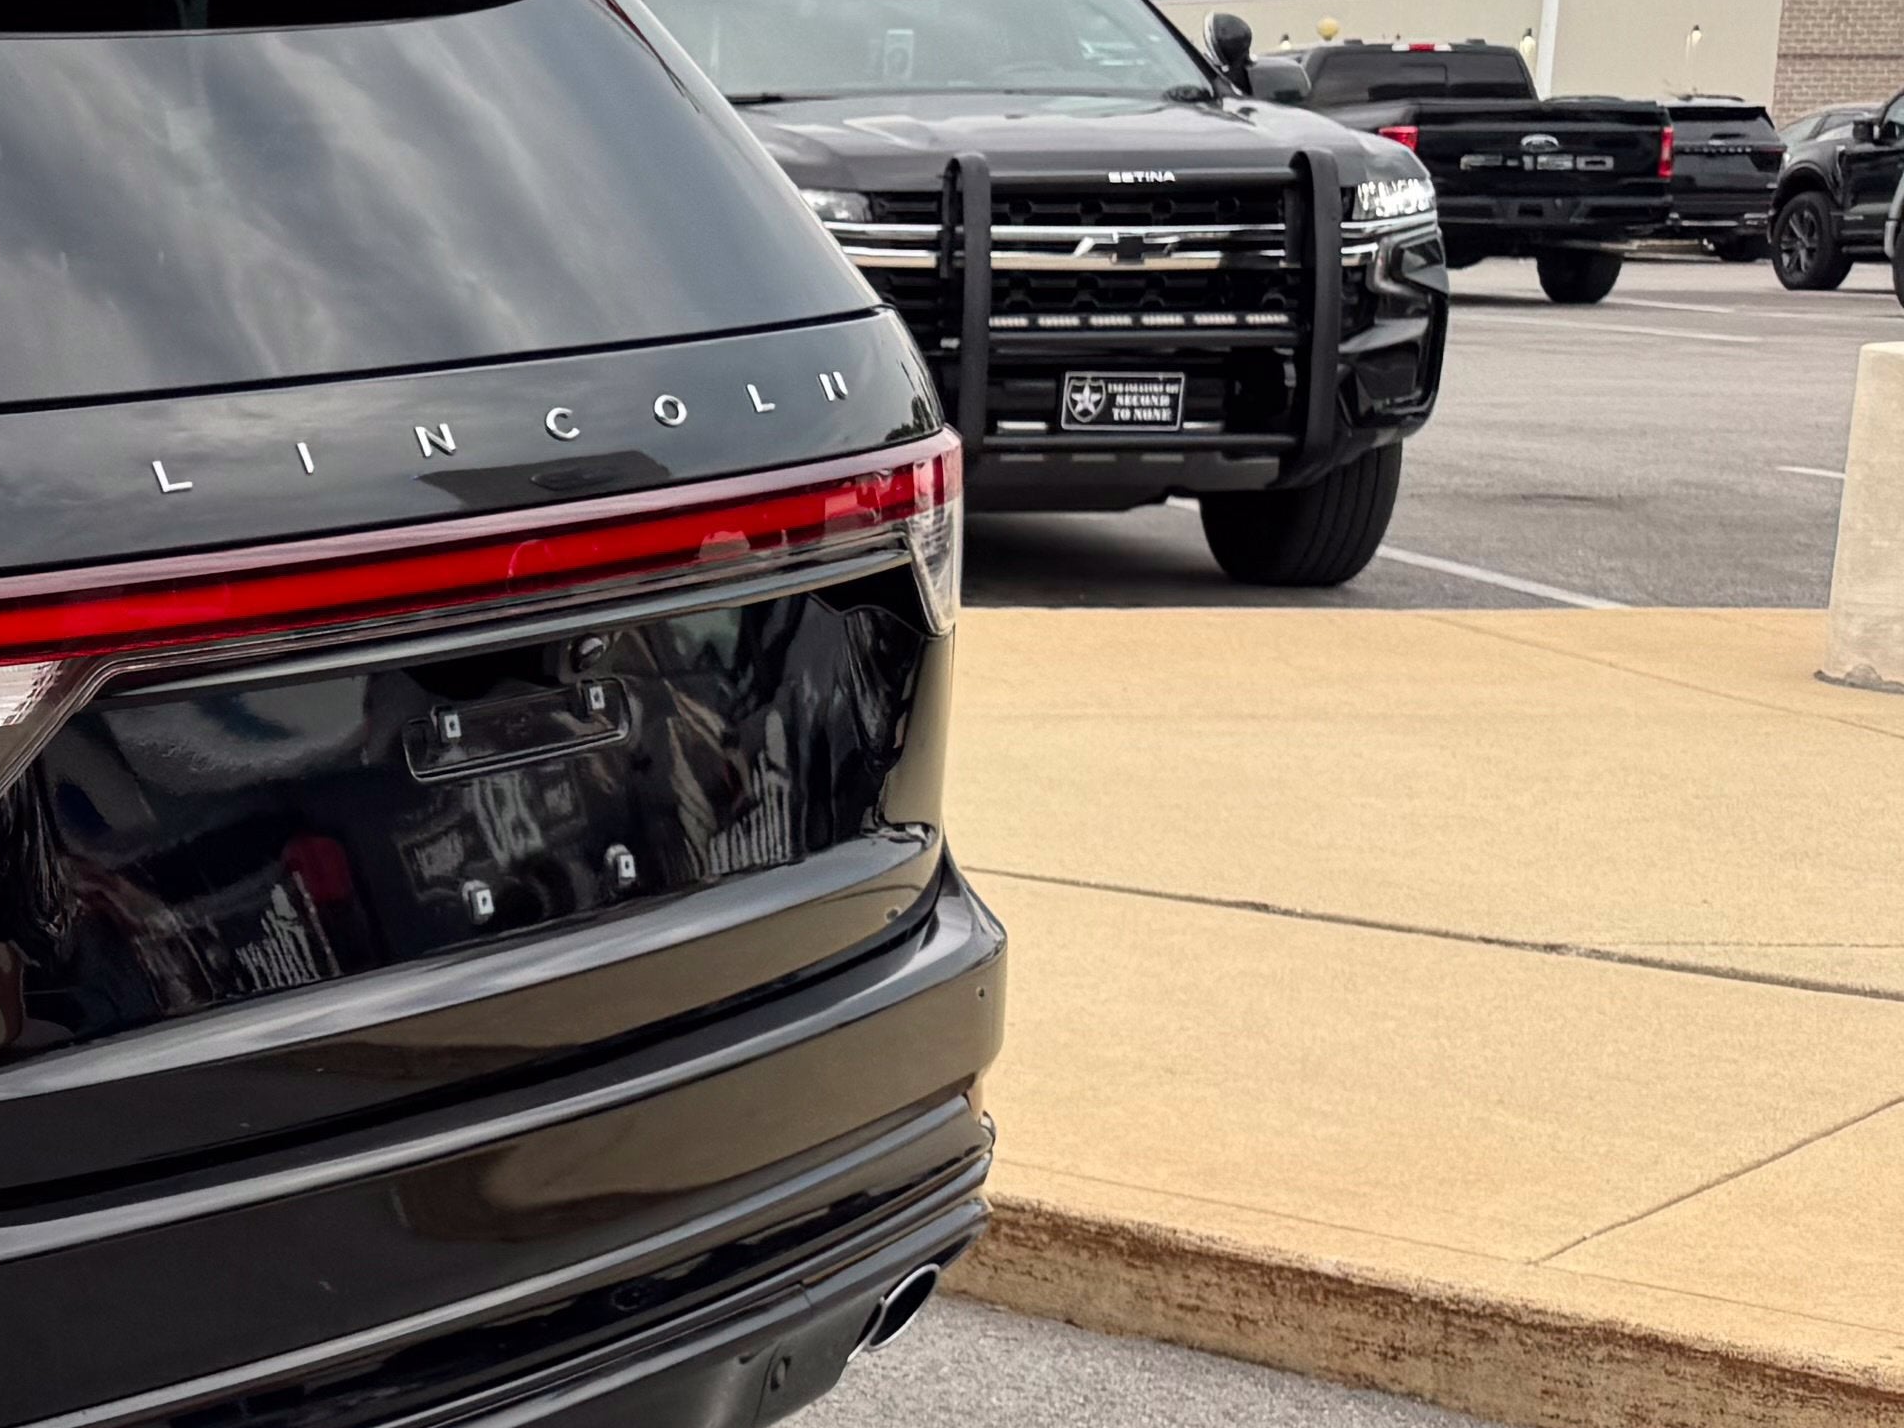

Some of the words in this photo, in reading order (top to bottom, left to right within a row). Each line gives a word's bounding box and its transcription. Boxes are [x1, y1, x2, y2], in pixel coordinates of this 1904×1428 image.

[152, 371, 851, 494] LINCOLN
[1112, 408, 1131, 421] TO
[1133, 407, 1173, 422] NONE
